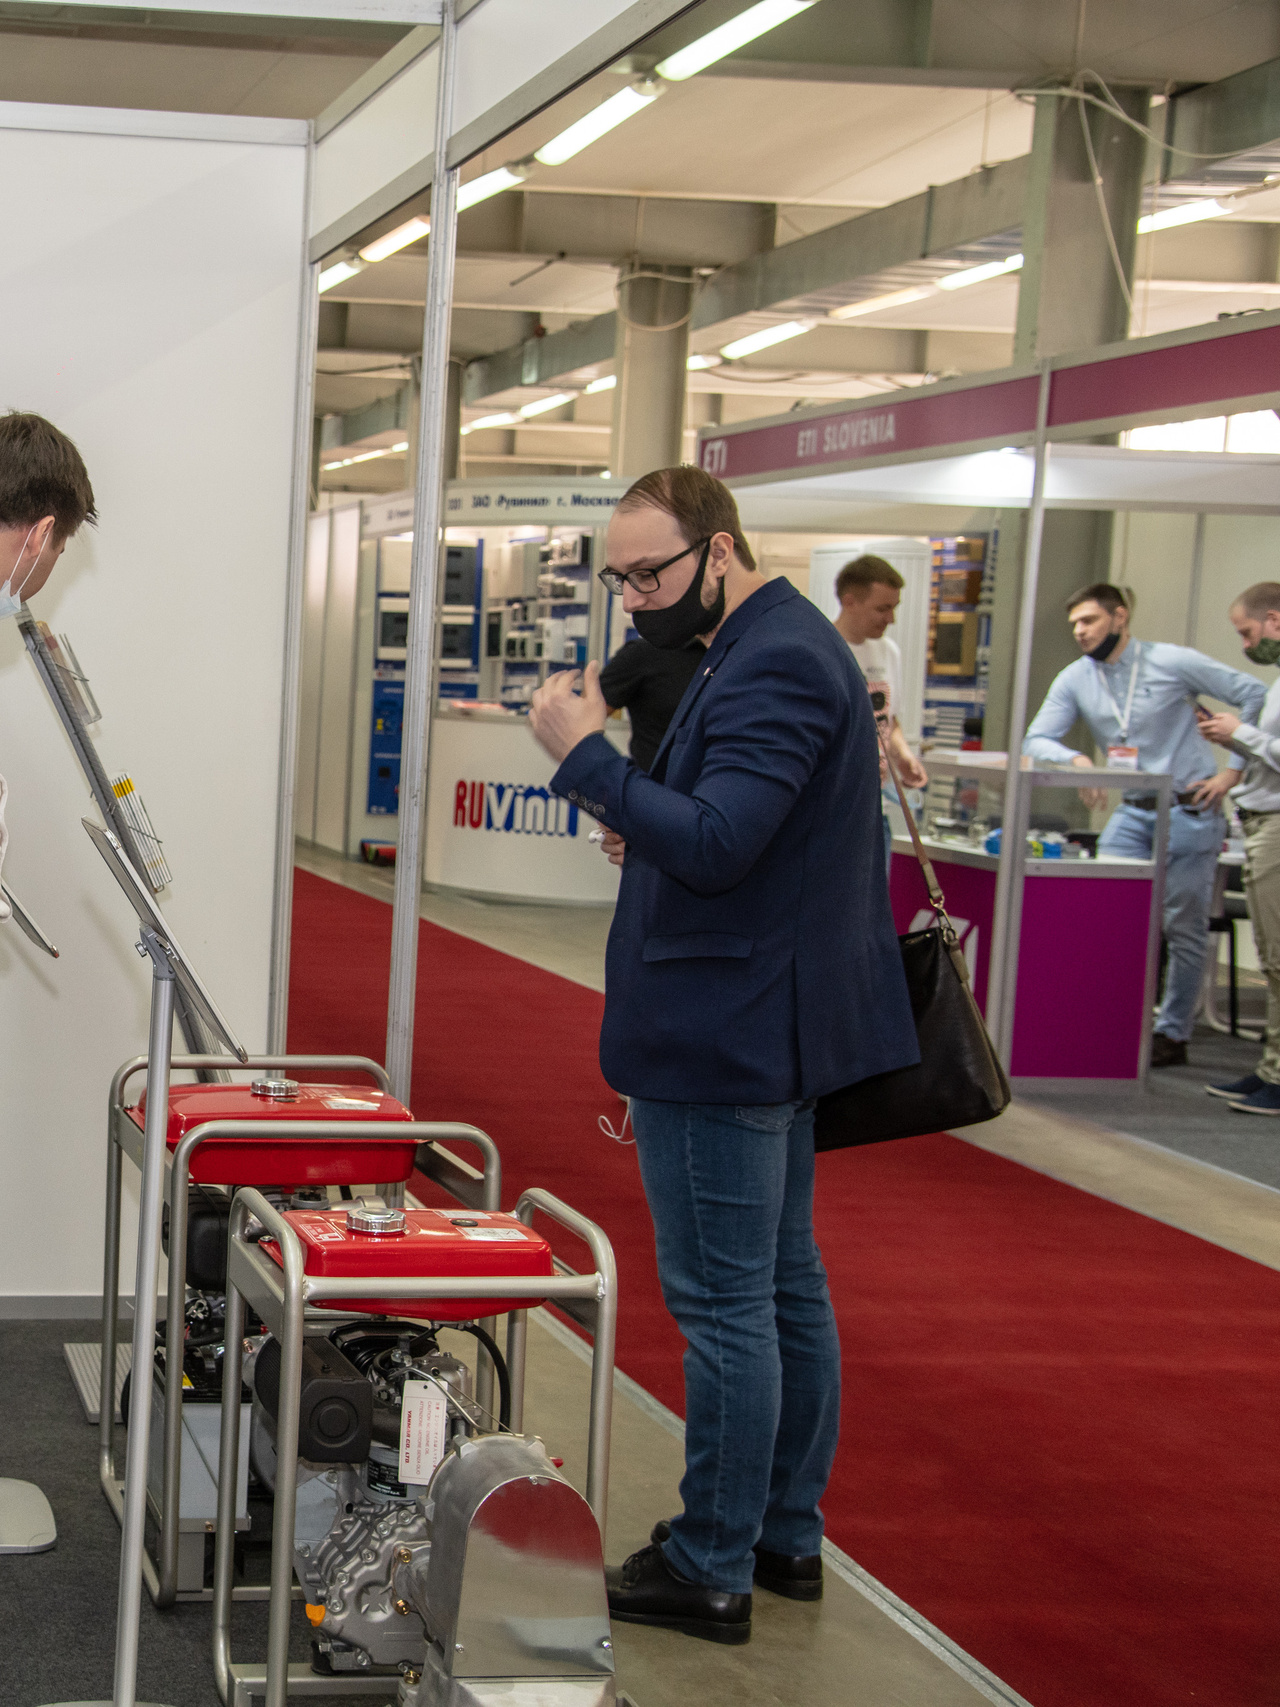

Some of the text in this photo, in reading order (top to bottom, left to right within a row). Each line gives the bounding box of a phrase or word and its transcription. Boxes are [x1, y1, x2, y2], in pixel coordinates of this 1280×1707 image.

[797, 413, 896, 458] ETI SLOVENIA
[703, 439, 728, 475] ETI
